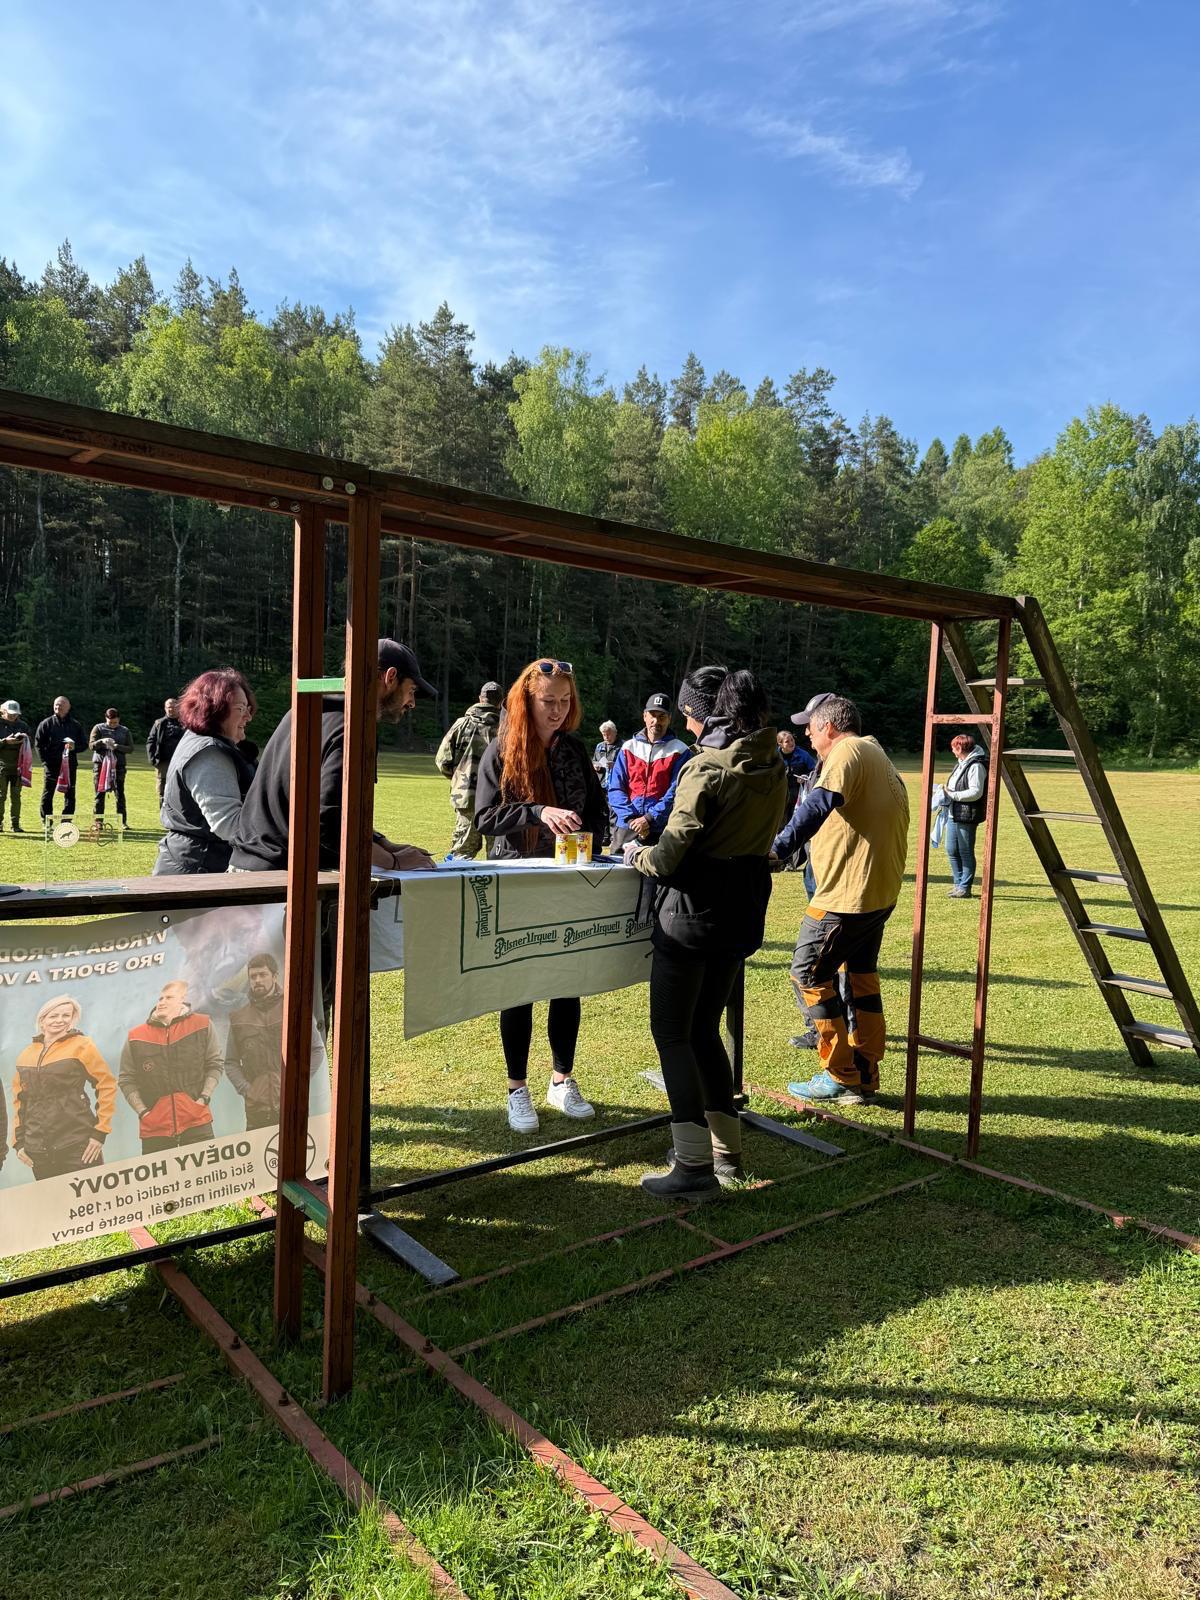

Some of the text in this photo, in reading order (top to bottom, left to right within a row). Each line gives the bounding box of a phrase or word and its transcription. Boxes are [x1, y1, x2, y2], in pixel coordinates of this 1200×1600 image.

[469, 875, 493, 939] Pilsner Urquell
[494, 929, 557, 959] Pilsner Urquell
[563, 921, 621, 948] Pilsner Urquell
